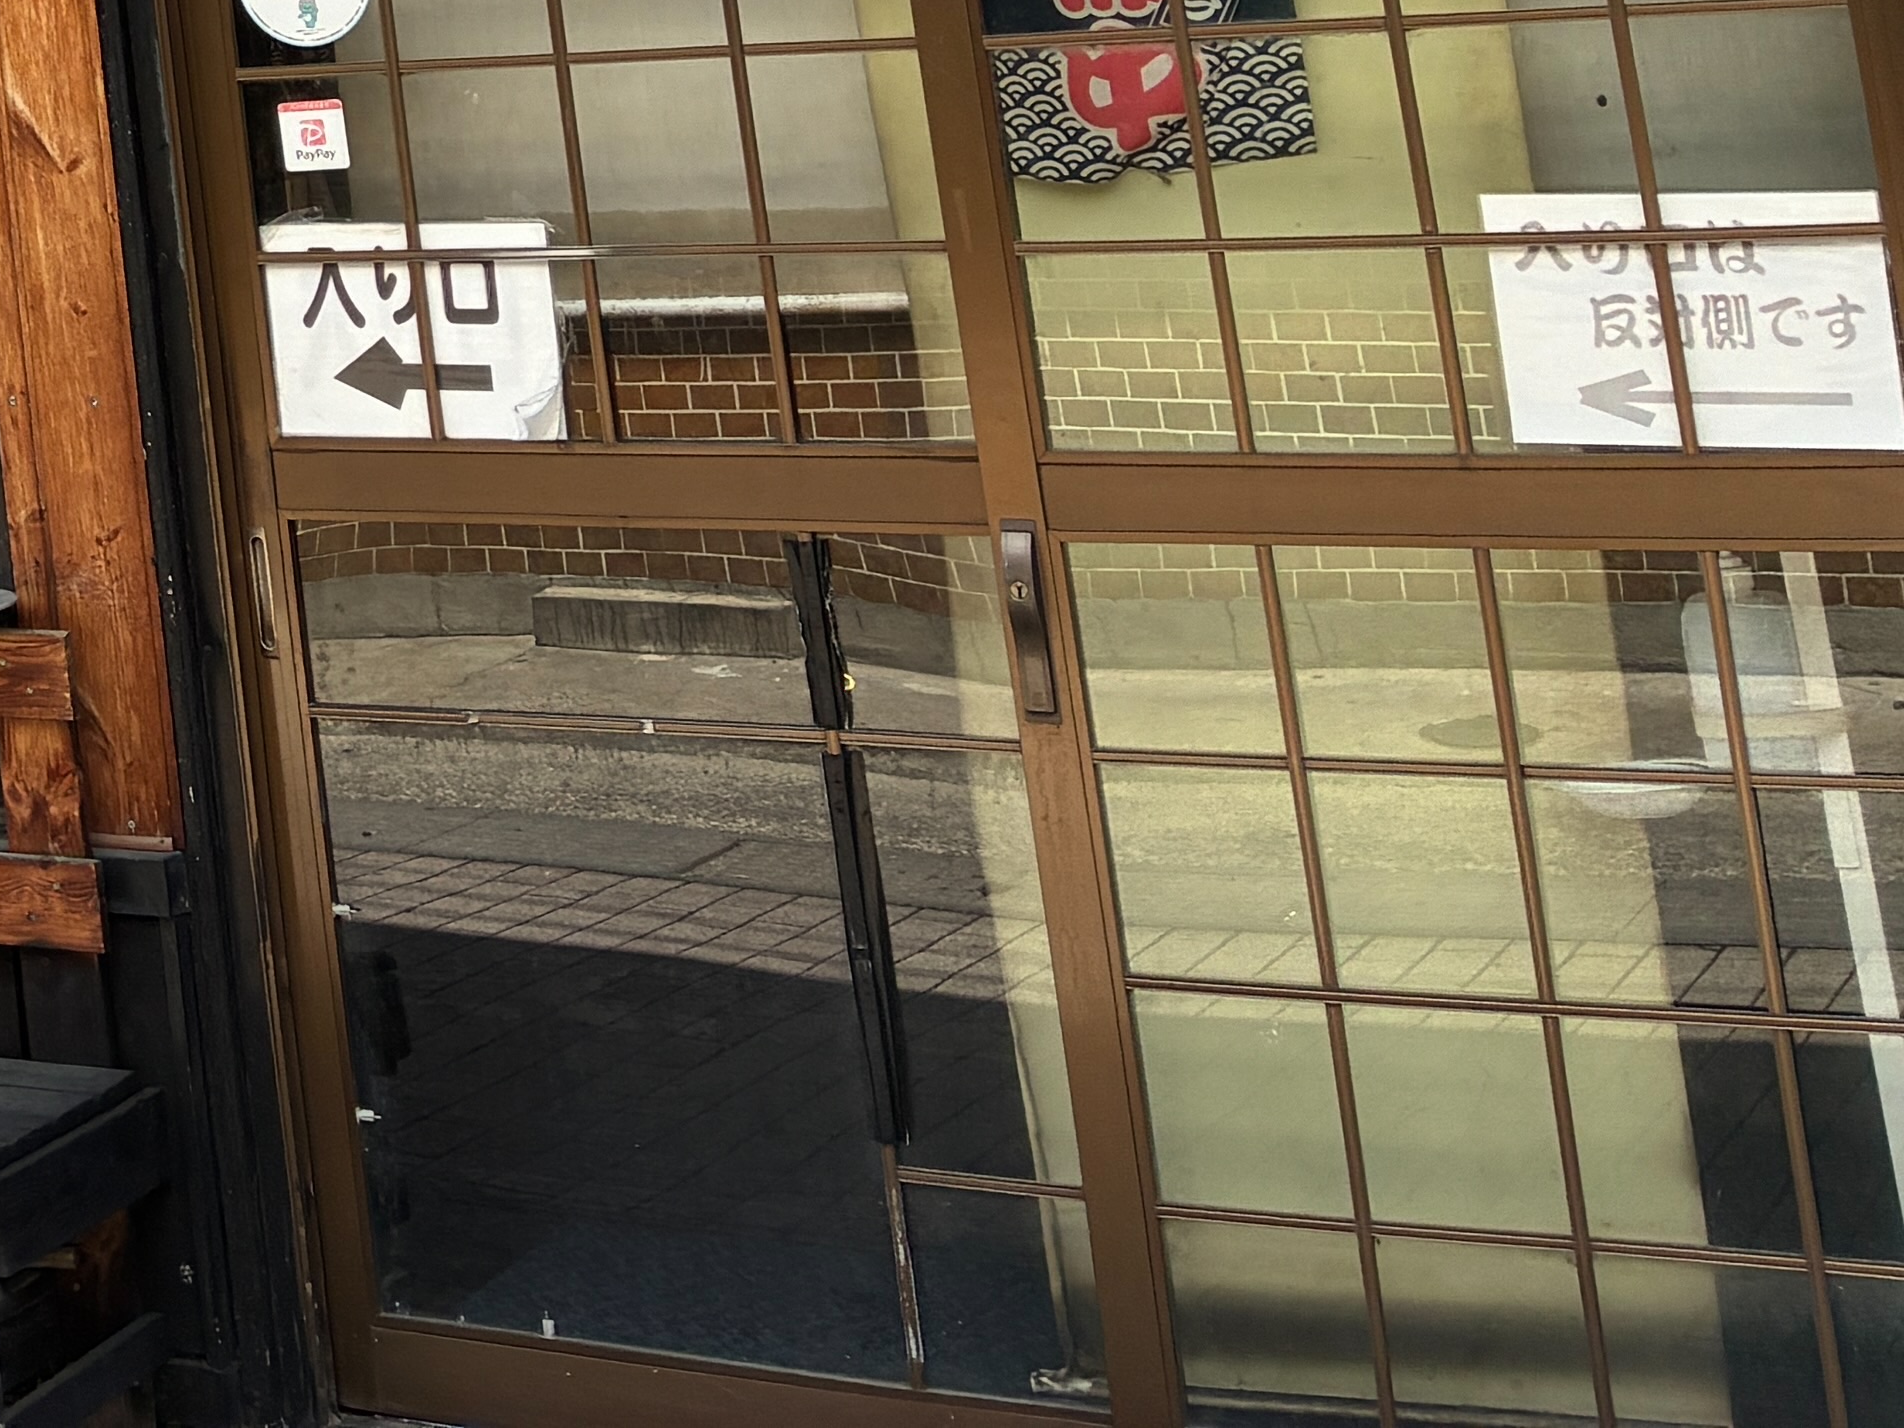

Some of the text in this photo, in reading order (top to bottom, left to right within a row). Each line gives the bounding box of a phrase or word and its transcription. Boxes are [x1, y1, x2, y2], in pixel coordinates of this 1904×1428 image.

[296, 148, 336, 161] PayPay
[303, 246, 499, 329] 入り口
[1591, 293, 1865, 349] 反対側です
